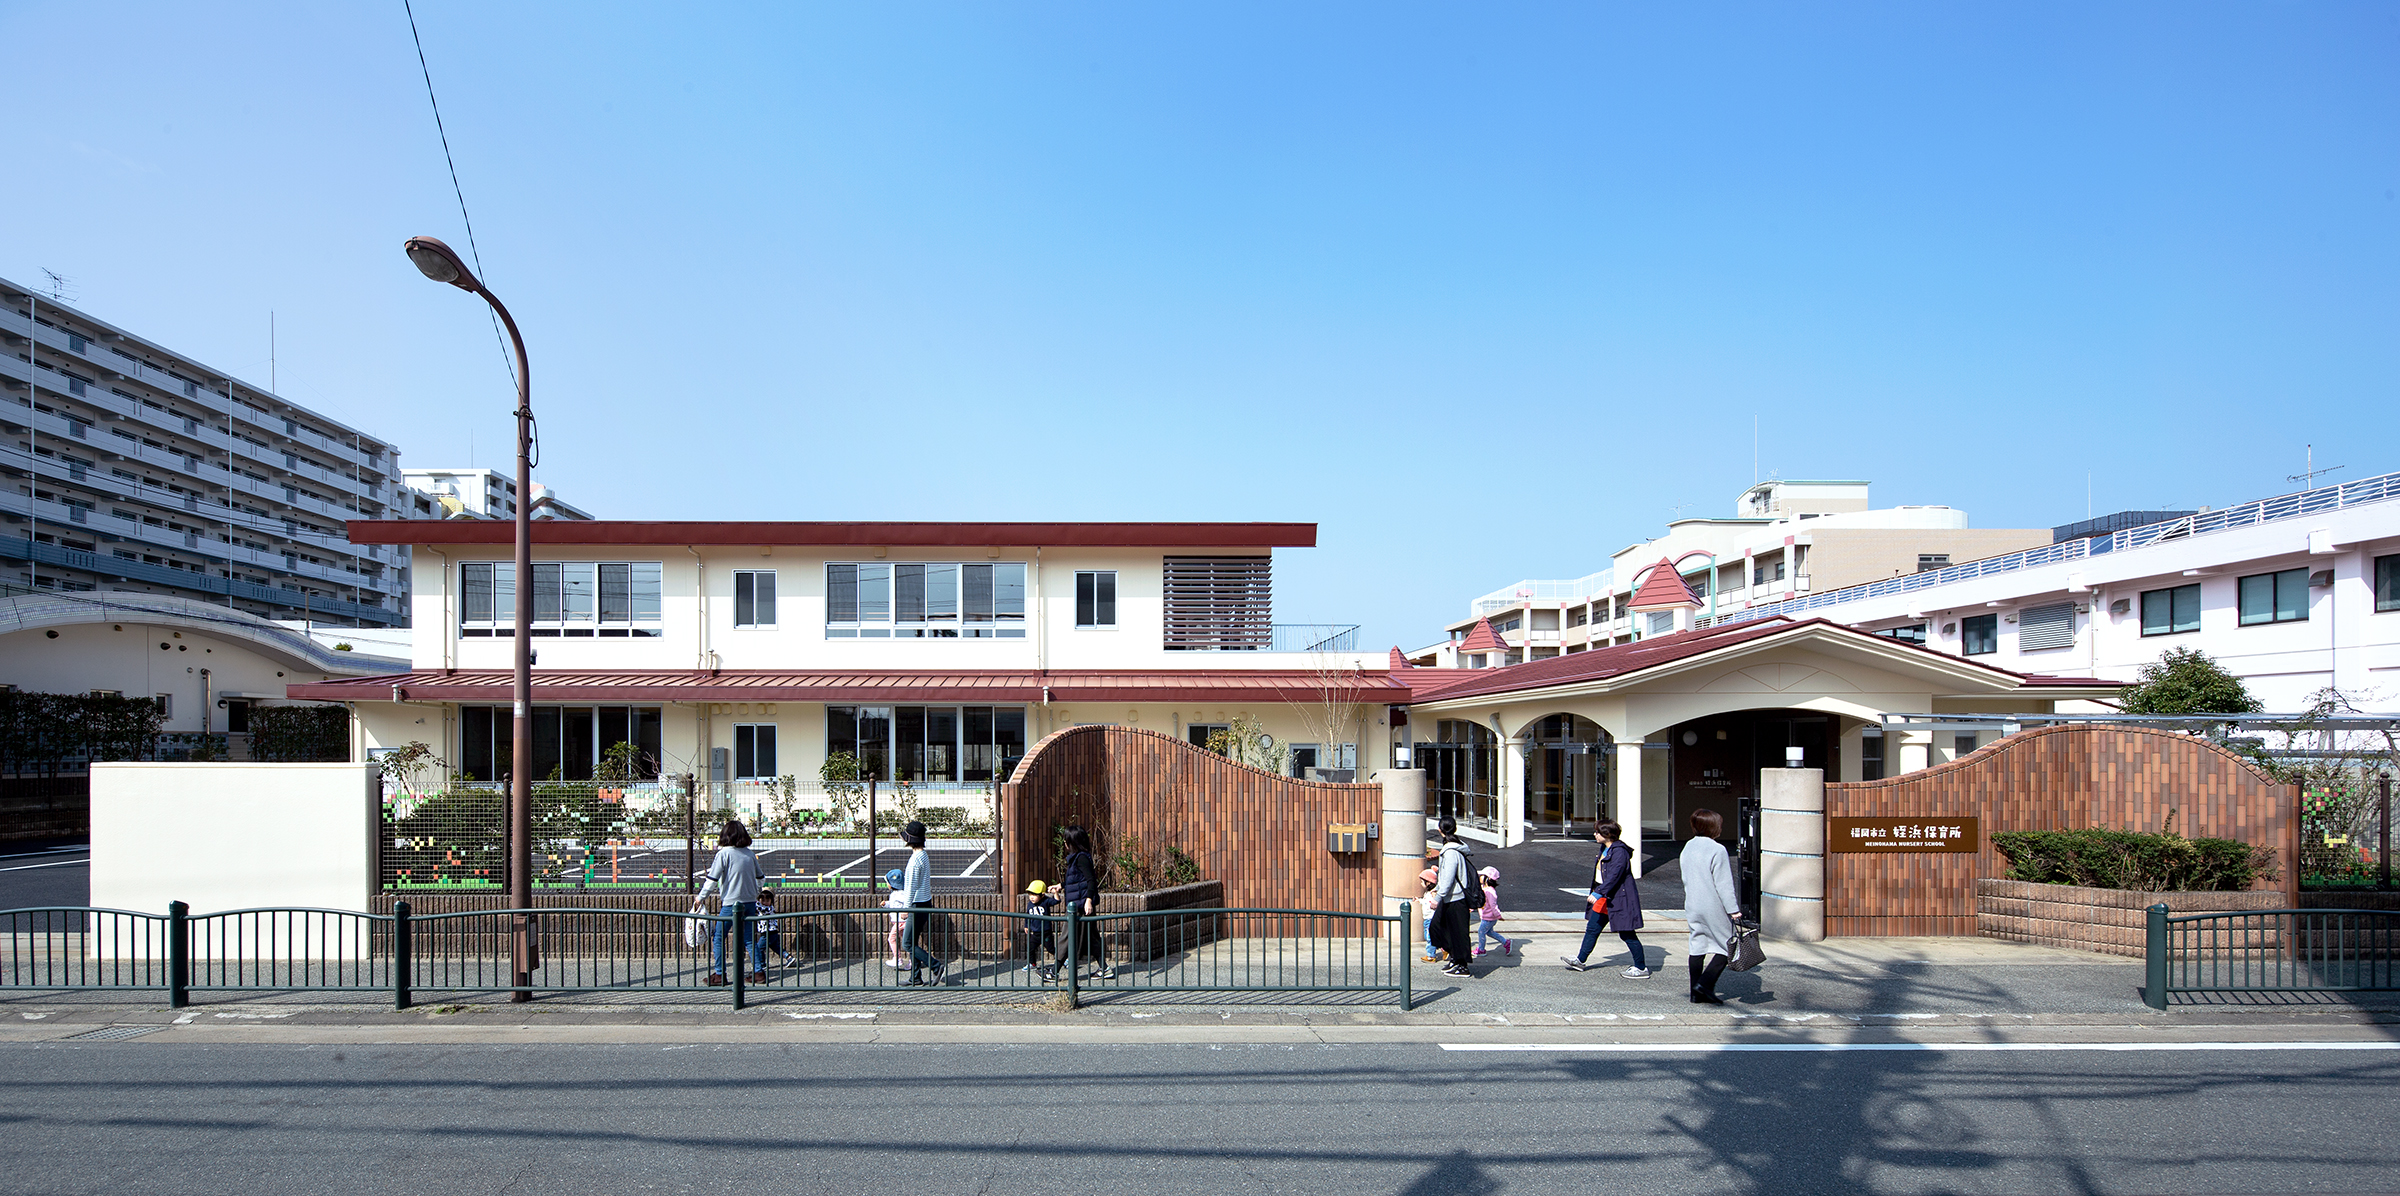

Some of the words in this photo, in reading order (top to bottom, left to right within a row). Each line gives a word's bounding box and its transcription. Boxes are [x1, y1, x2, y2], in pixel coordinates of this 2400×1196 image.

[1850, 827, 1887, 838] 福岡市立
[1892, 824, 1962, 839] 姪浜保育所
[1028, 905, 1045, 916] GAP
